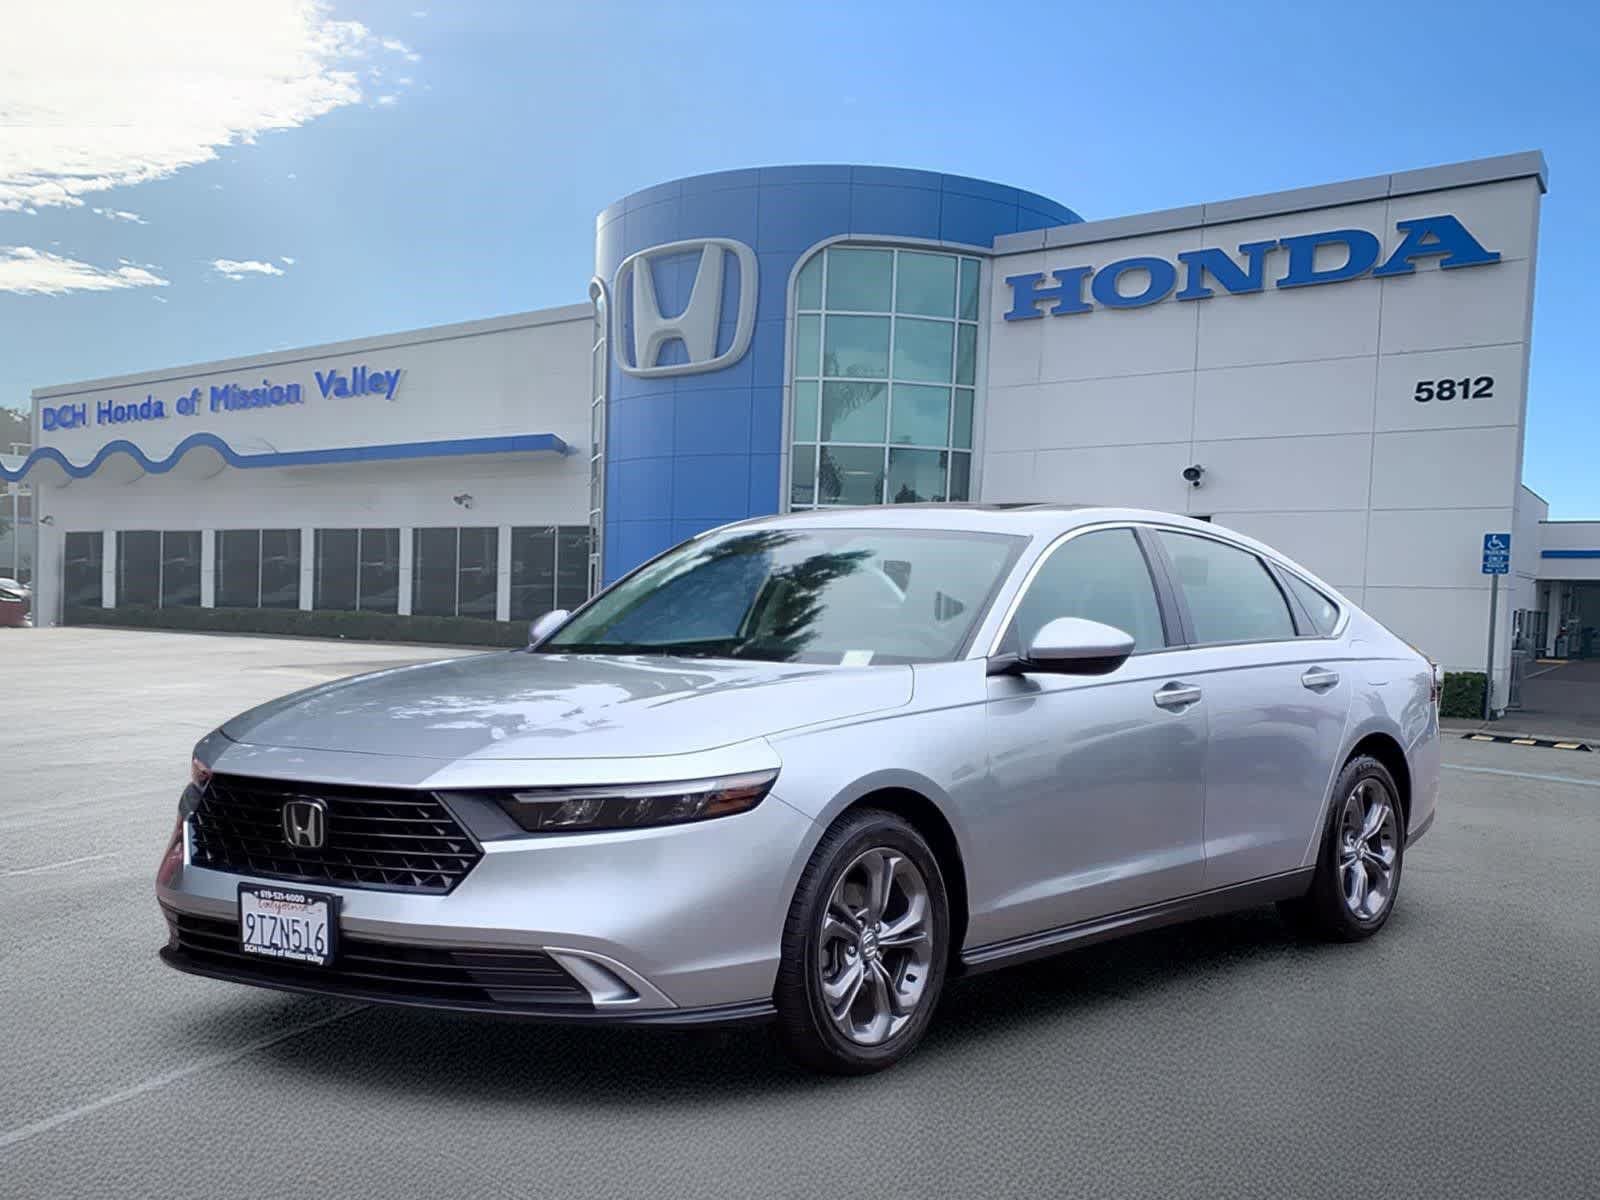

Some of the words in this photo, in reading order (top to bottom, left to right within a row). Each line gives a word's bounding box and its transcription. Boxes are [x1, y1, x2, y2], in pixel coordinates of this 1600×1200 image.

[1004, 214, 1500, 321] HONDA
[42, 403, 87, 431] DCH
[97, 394, 165, 425] Honda
[176, 387, 202, 416] of
[209, 379, 303, 412] Mission
[314, 365, 401, 401] Valley
[1414, 376, 1494, 402] 5812
[246, 913, 324, 955] 9TZN516
